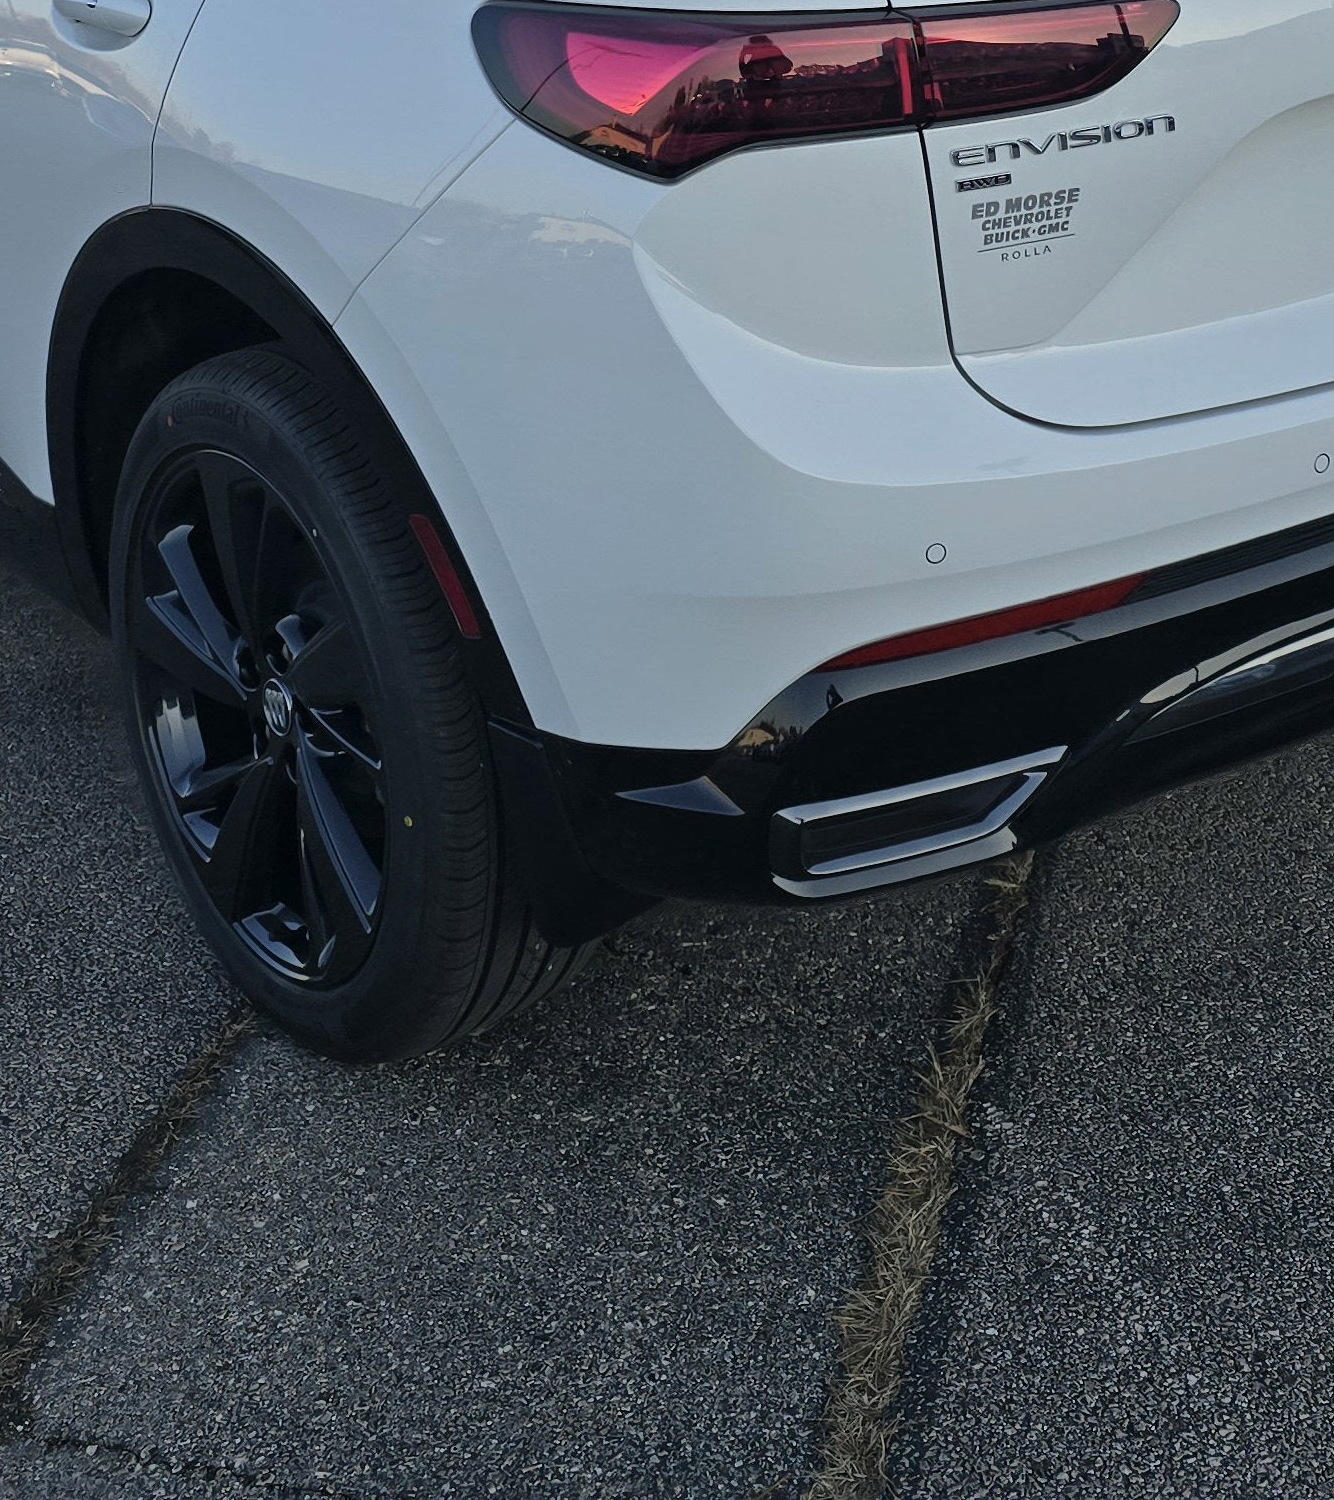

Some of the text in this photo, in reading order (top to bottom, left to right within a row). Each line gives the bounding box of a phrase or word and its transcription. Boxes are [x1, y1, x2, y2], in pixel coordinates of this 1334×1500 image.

[949, 113, 1176, 167] ENVISION
[971, 187, 1081, 220] ED MORSE
[981, 206, 1073, 232] CHEVROLET
[1000, 244, 1052, 262] ROLLA
